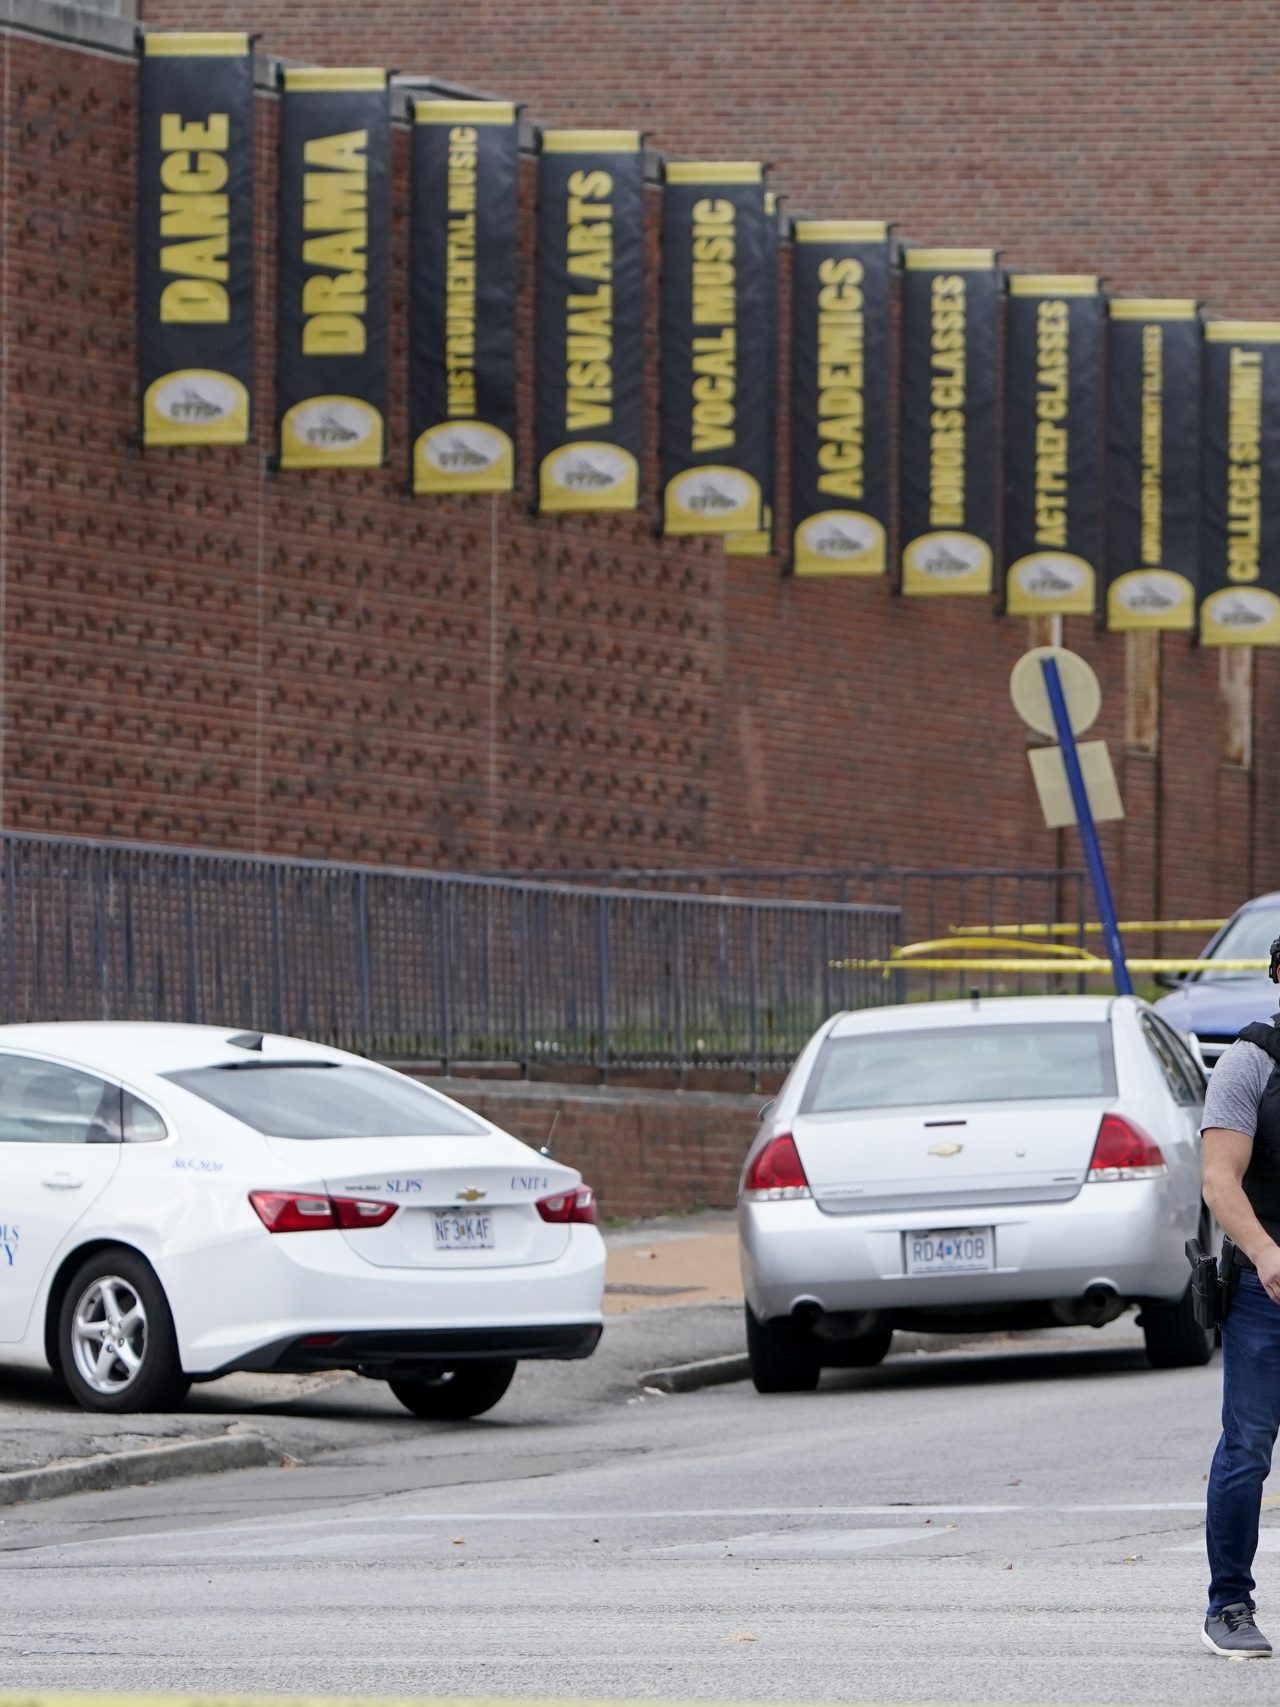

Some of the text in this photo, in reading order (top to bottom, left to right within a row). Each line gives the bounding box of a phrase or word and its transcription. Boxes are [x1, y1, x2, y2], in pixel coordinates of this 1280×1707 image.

[160, 112, 230, 324] DANCE
[302, 129, 369, 356] DRAMA
[446, 126, 478, 417] INSTRUMENTAL MUSIC
[565, 170, 613, 432] VISUAL ARTS
[691, 198, 736, 453] VOCAL MUSIC
[931, 274, 966, 408] CLASSES
[1036, 299, 1069, 420] CLASSES
[817, 258, 864, 500] ACADEMICS
[1229, 347, 1263, 464] SUMMIT
[929, 408, 965, 527] HONORS
[1035, 420, 1068, 491] PREP
[1035, 492, 1068, 547] ACT
[1227, 465, 1260, 582] COLLEGE
[386, 1178, 423, 1193] SLPS
[511, 1176, 538, 1190] UNIT
